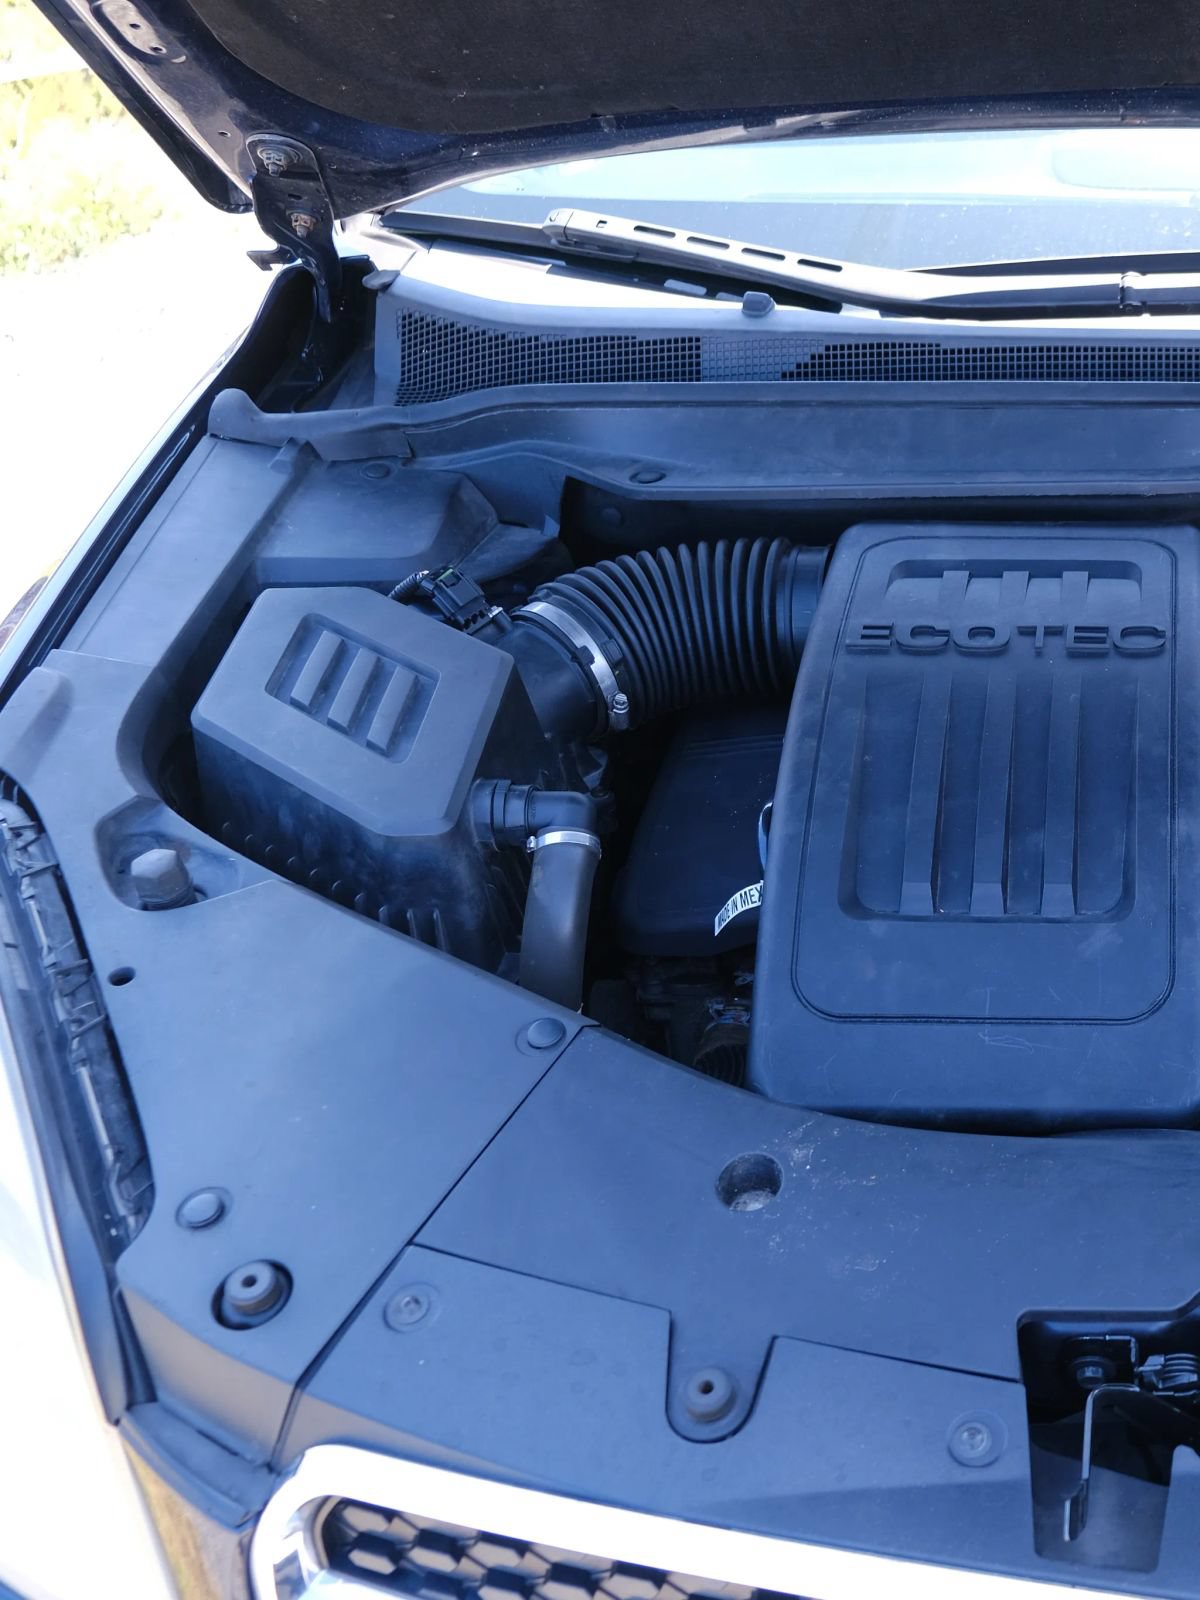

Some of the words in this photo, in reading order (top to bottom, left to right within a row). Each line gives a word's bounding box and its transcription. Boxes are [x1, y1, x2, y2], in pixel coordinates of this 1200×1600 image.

[845, 622, 1167, 653] ECOTEC
[717, 903, 730, 930] MADE
[731, 897, 738, 915] IN
